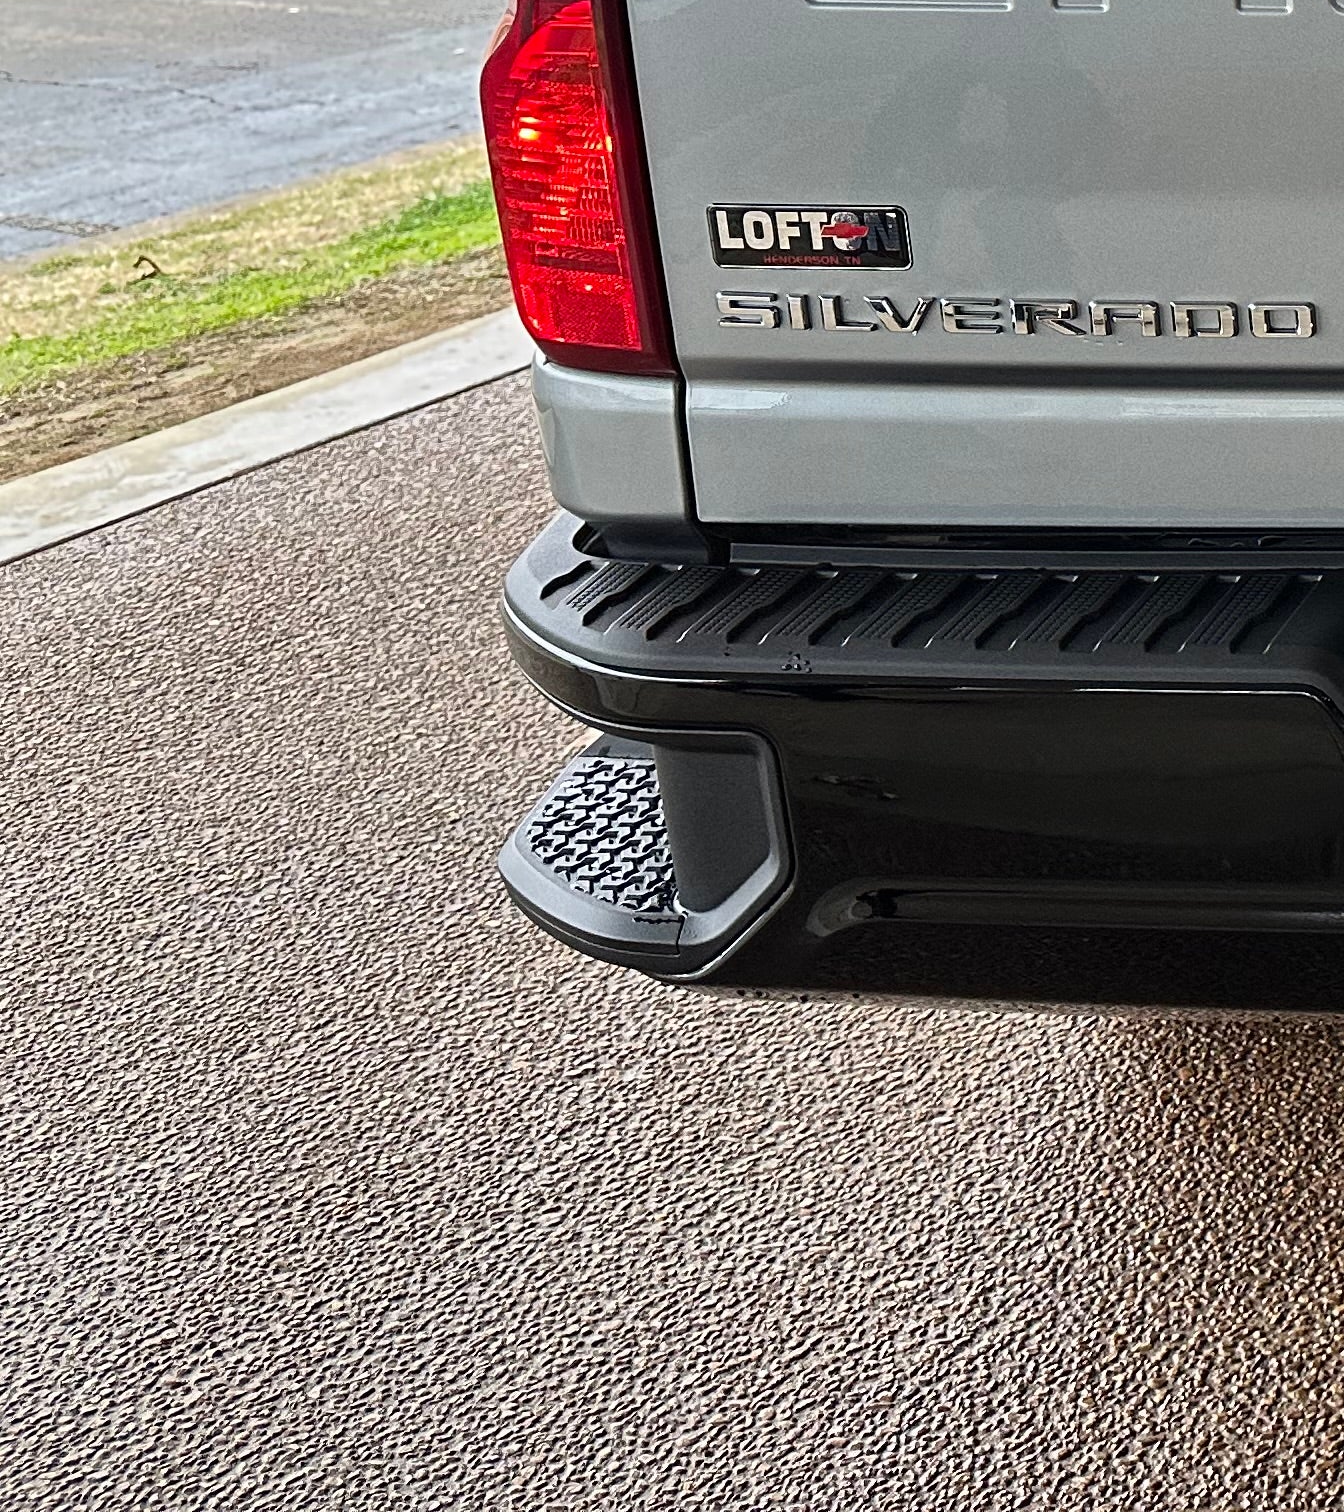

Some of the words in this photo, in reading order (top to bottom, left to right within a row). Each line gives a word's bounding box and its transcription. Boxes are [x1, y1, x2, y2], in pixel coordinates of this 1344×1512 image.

[715, 210, 901, 251] LOFTON
[845, 256, 861, 265] TN
[715, 290, 1318, 339] SILVERADO
